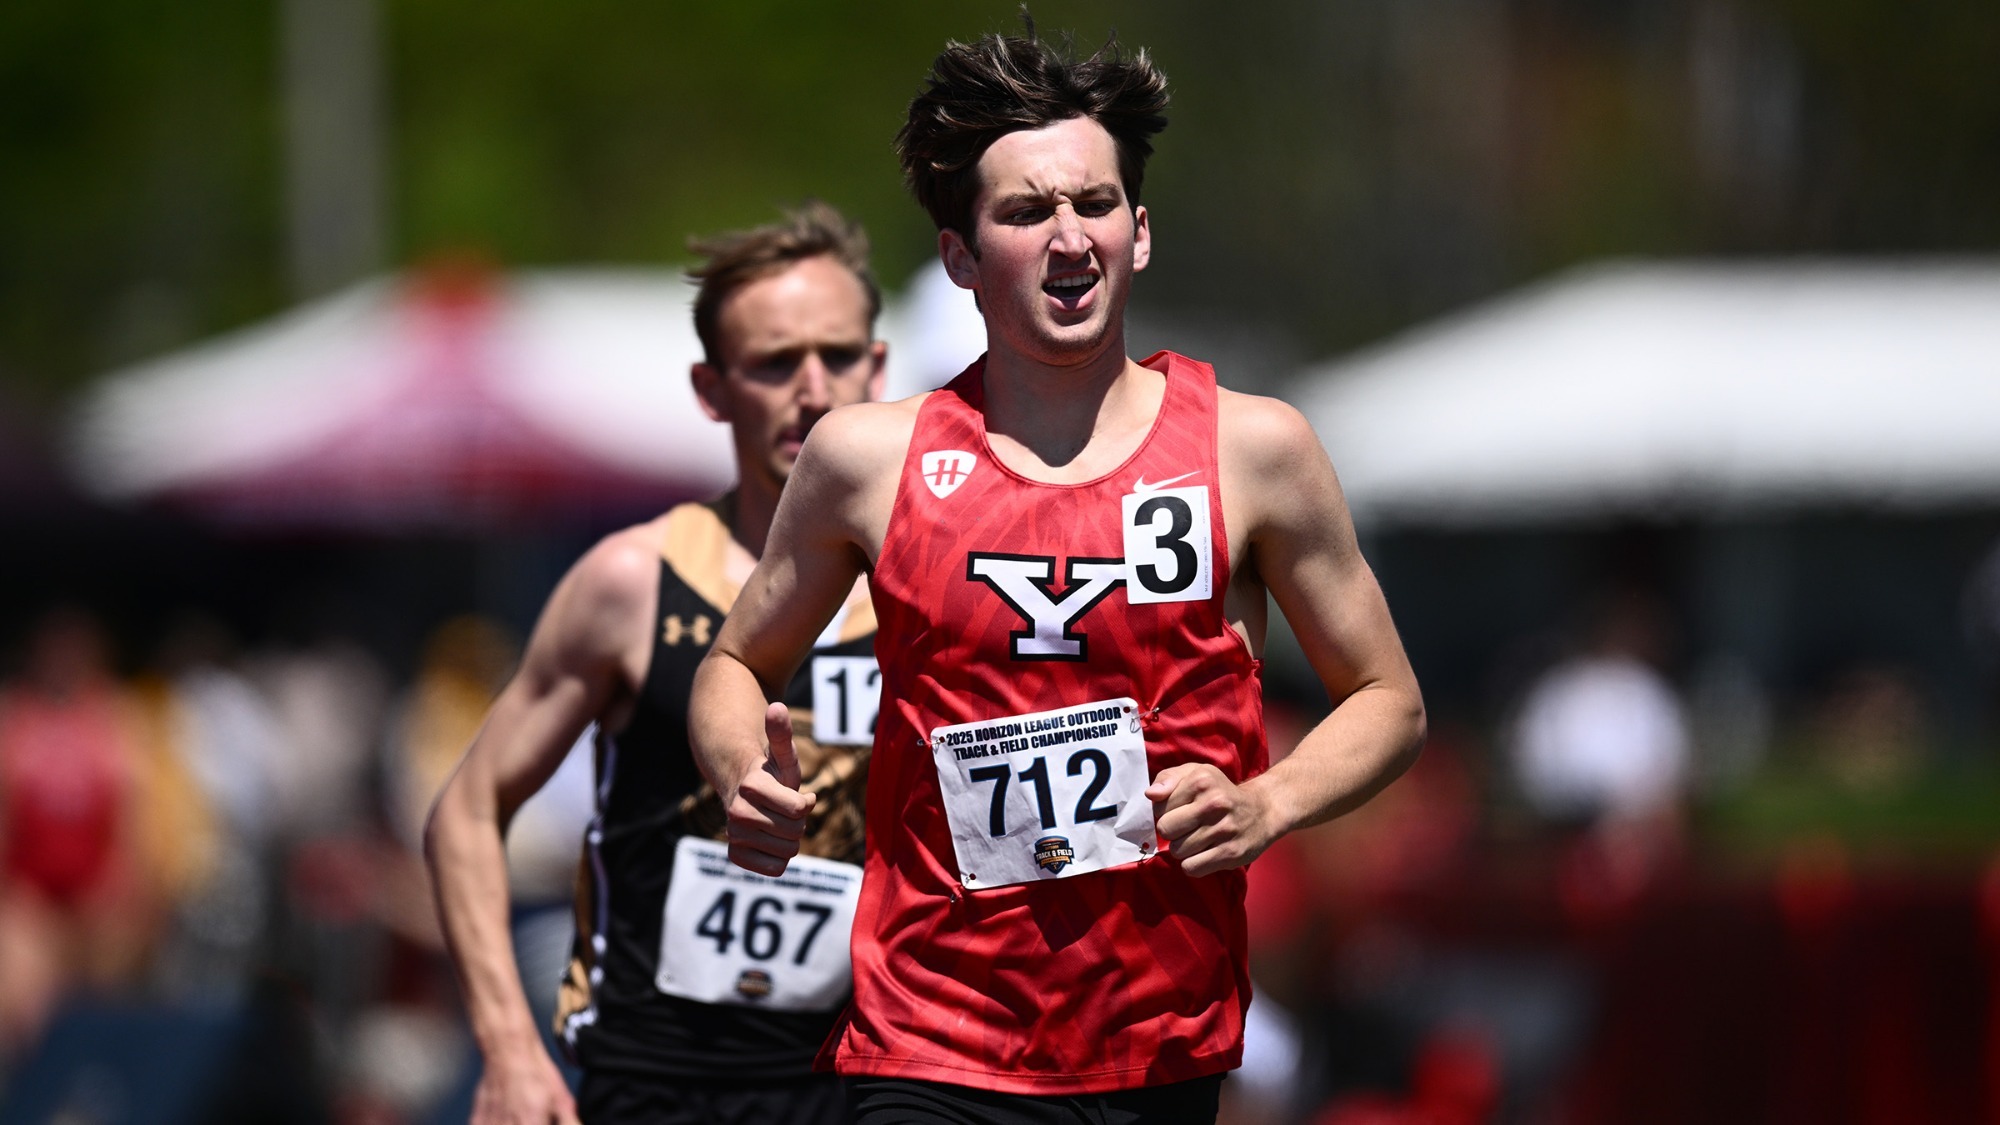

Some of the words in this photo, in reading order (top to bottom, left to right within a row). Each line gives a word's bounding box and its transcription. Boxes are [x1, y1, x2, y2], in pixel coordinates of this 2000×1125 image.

[1133, 495, 1199, 595] 3
[966, 551, 1127, 662] Y
[946, 730, 974, 747] 2025
[975, 723, 1022, 742] HORIZON
[1024, 716, 1065, 734] LEAGUE
[1067, 707, 1122, 726] OUTDOOR
[954, 743, 990, 761] TRACK
[990, 742, 999, 756] &
[1000, 737, 1029, 755] FIELD
[1031, 723, 1118, 750] CHAMPIONSHIP
[968, 748, 1118, 838] 712
[1036, 851, 1051, 860] TRACK
[696, 890, 833, 966] 467
